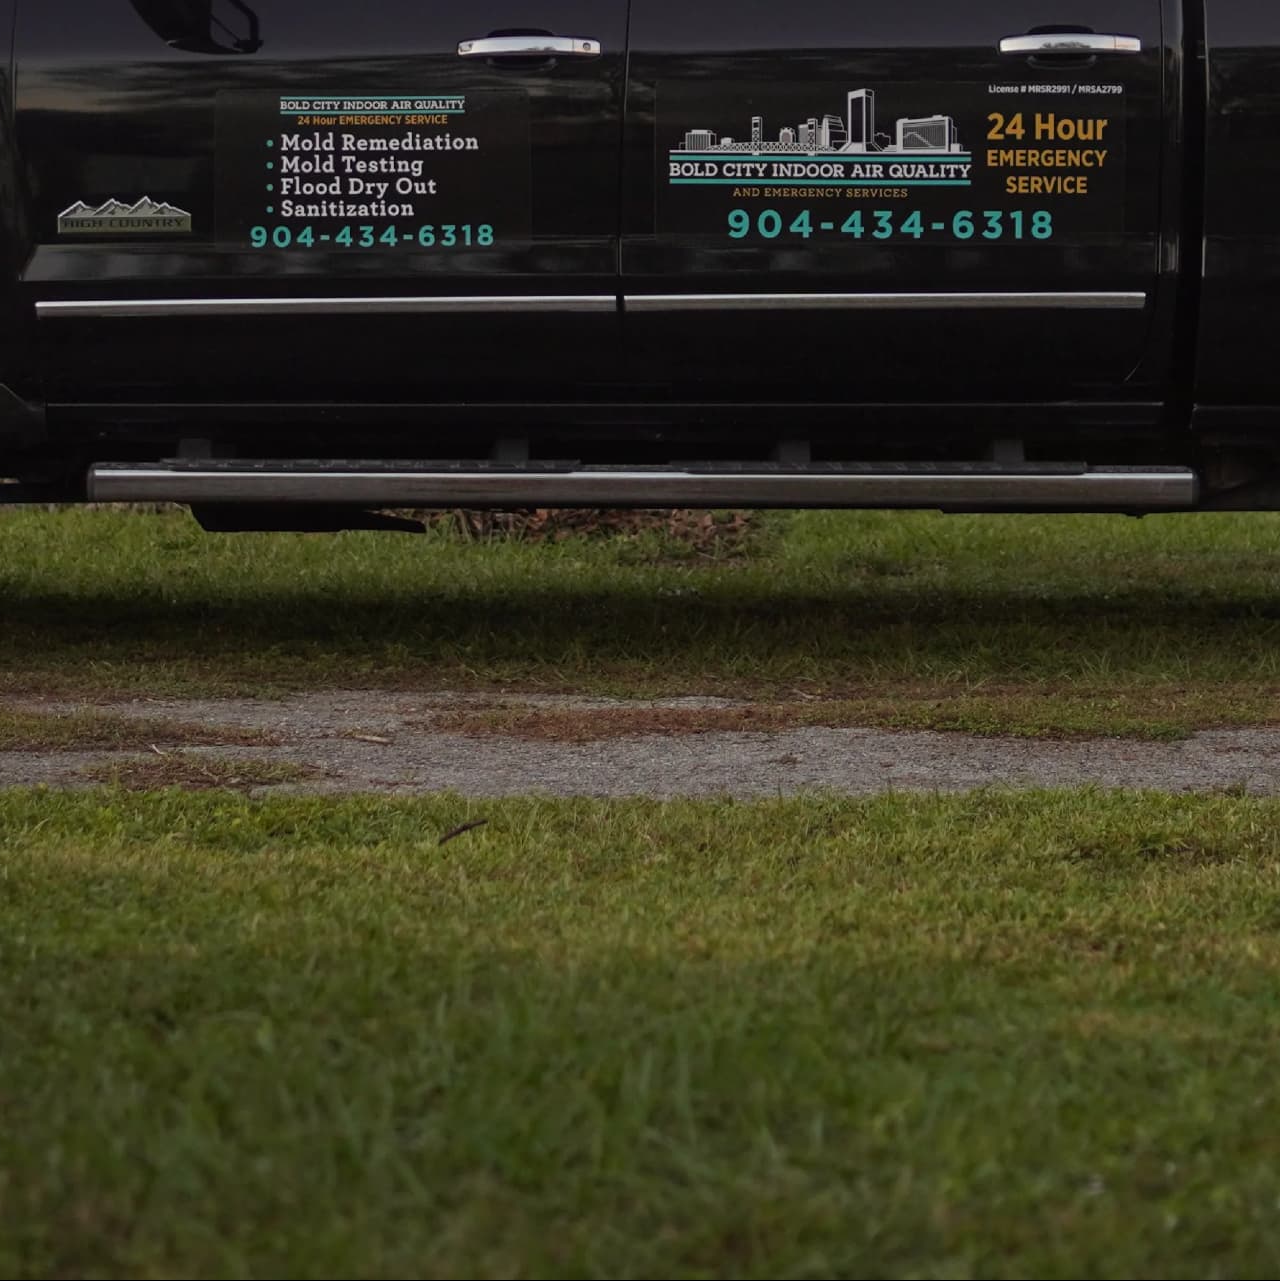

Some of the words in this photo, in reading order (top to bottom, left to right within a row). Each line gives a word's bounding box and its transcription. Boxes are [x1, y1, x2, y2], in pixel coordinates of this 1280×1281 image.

[988, 84, 1019, 93] License
[1020, 84, 1027, 93] #
[280, 100, 310, 110] BOLD
[313, 100, 339, 110] CITY
[343, 100, 388, 110] INDOOR
[391, 100, 412, 110] AIR
[414, 100, 465, 110] QUALITY
[297, 116, 310, 125] 24
[313, 116, 337, 125] Hour
[339, 115, 402, 125] EMERGENCY
[405, 115, 448, 125] SERVICE
[987, 113, 1025, 140] 24
[1035, 113, 1107, 140] Hour
[281, 132, 335, 151] Mold
[342, 132, 478, 151] Remediation
[281, 154, 335, 173] Mold
[342, 156, 424, 176] Testing
[987, 150, 1107, 167] EMERGENCY
[669, 163, 718, 176] BOLD
[723, 163, 767, 177] CITY
[772, 163, 844, 178] INDOOR
[851, 164, 884, 178] AIR
[889, 164, 971, 178] QUALITY
[281, 176, 341, 195] Flood
[349, 178, 389, 199] Dry
[396, 177, 436, 194] Out
[733, 188, 760, 197] AND
[764, 188, 842, 197] EMERGENCY
[846, 187, 909, 198] SERVICES
[1006, 176, 1087, 193] SERVICE
[281, 200, 414, 217] Sanitization
[728, 209, 1052, 239] 904-434-6318
[250, 224, 493, 248] 904-434-6318
